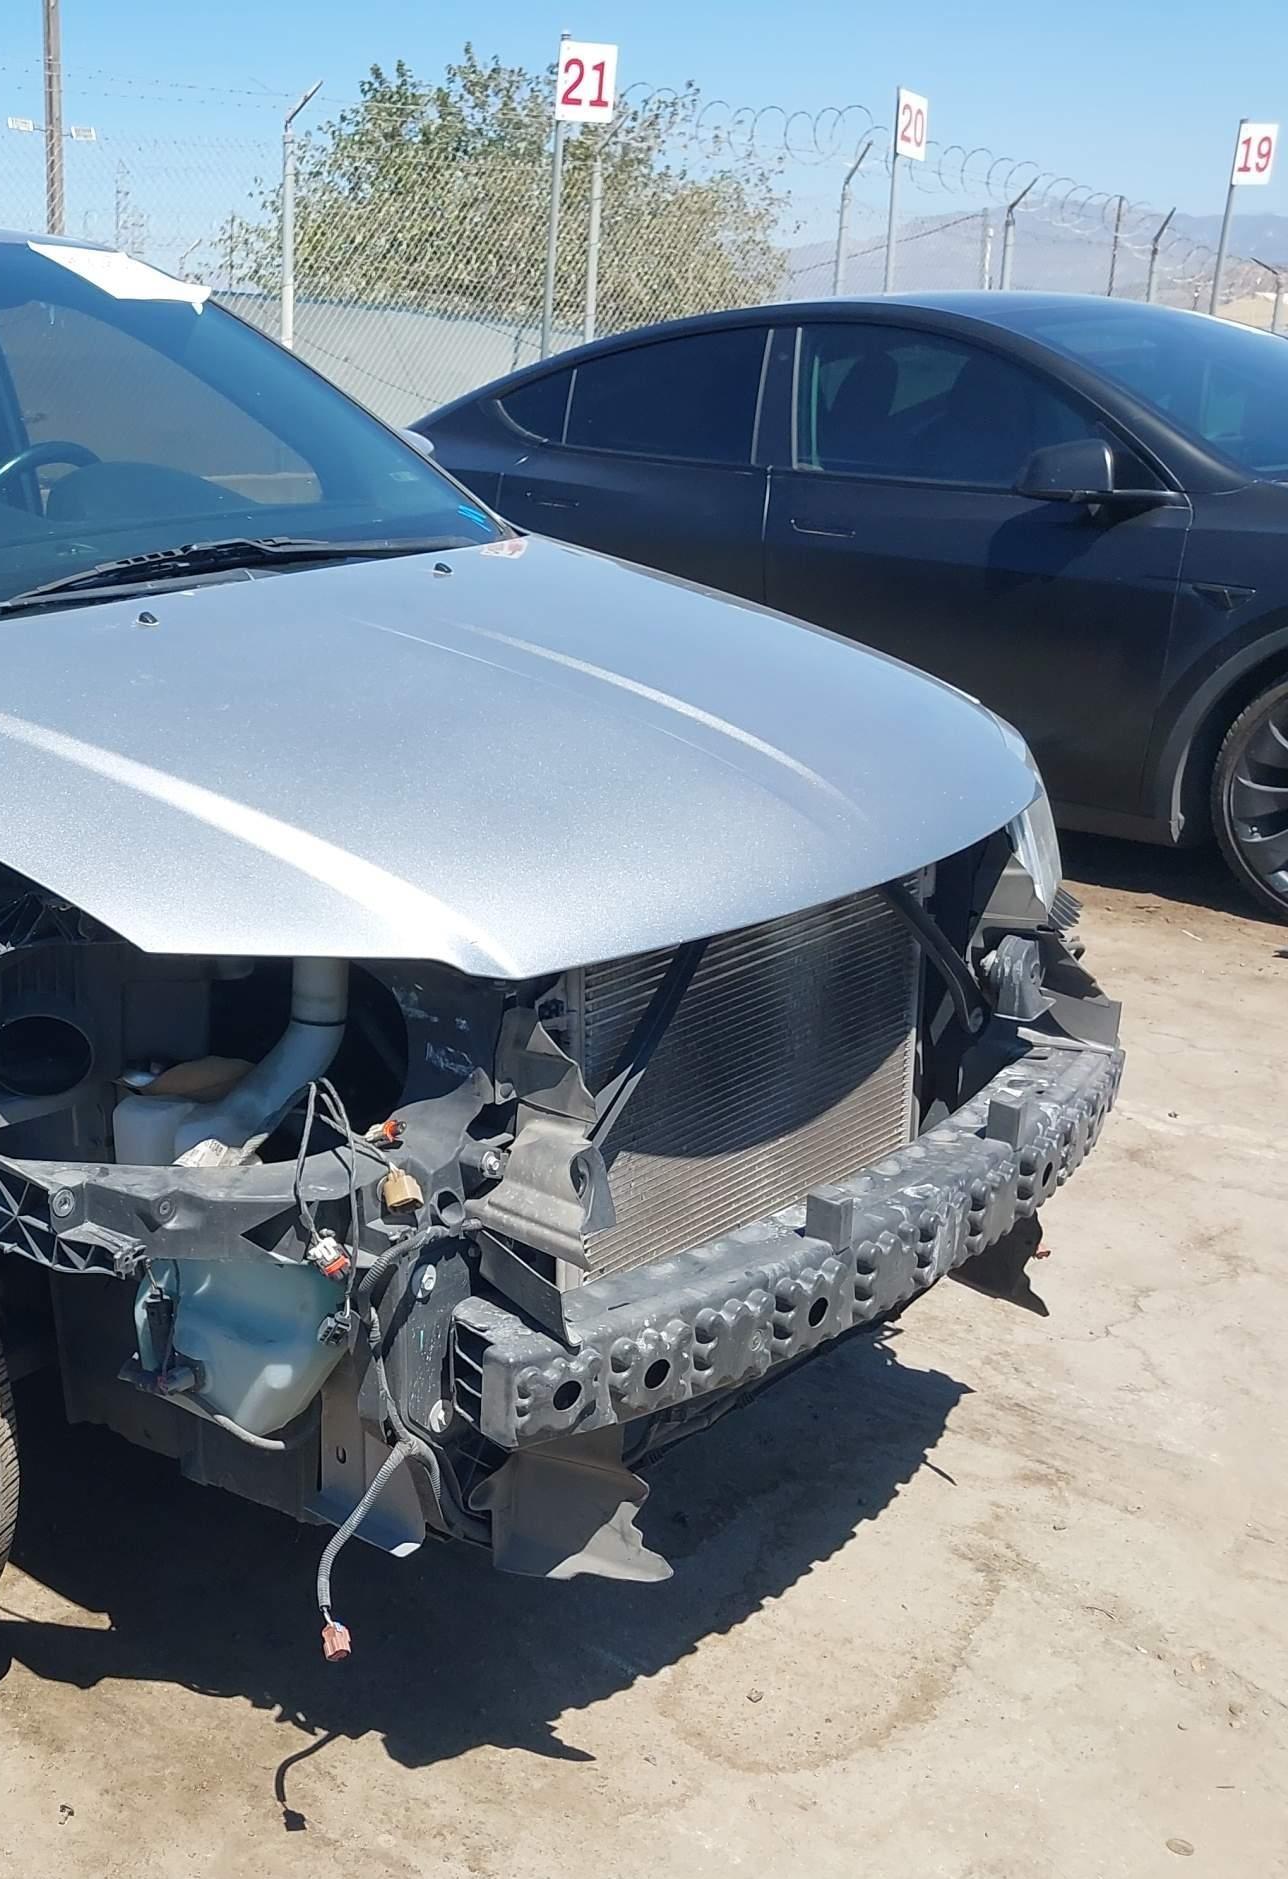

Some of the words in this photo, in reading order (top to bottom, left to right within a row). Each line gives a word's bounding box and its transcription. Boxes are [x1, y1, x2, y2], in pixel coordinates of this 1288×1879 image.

[561, 57, 609, 108] 21
[900, 103, 924, 148] 20
[1237, 136, 1272, 173] 19
